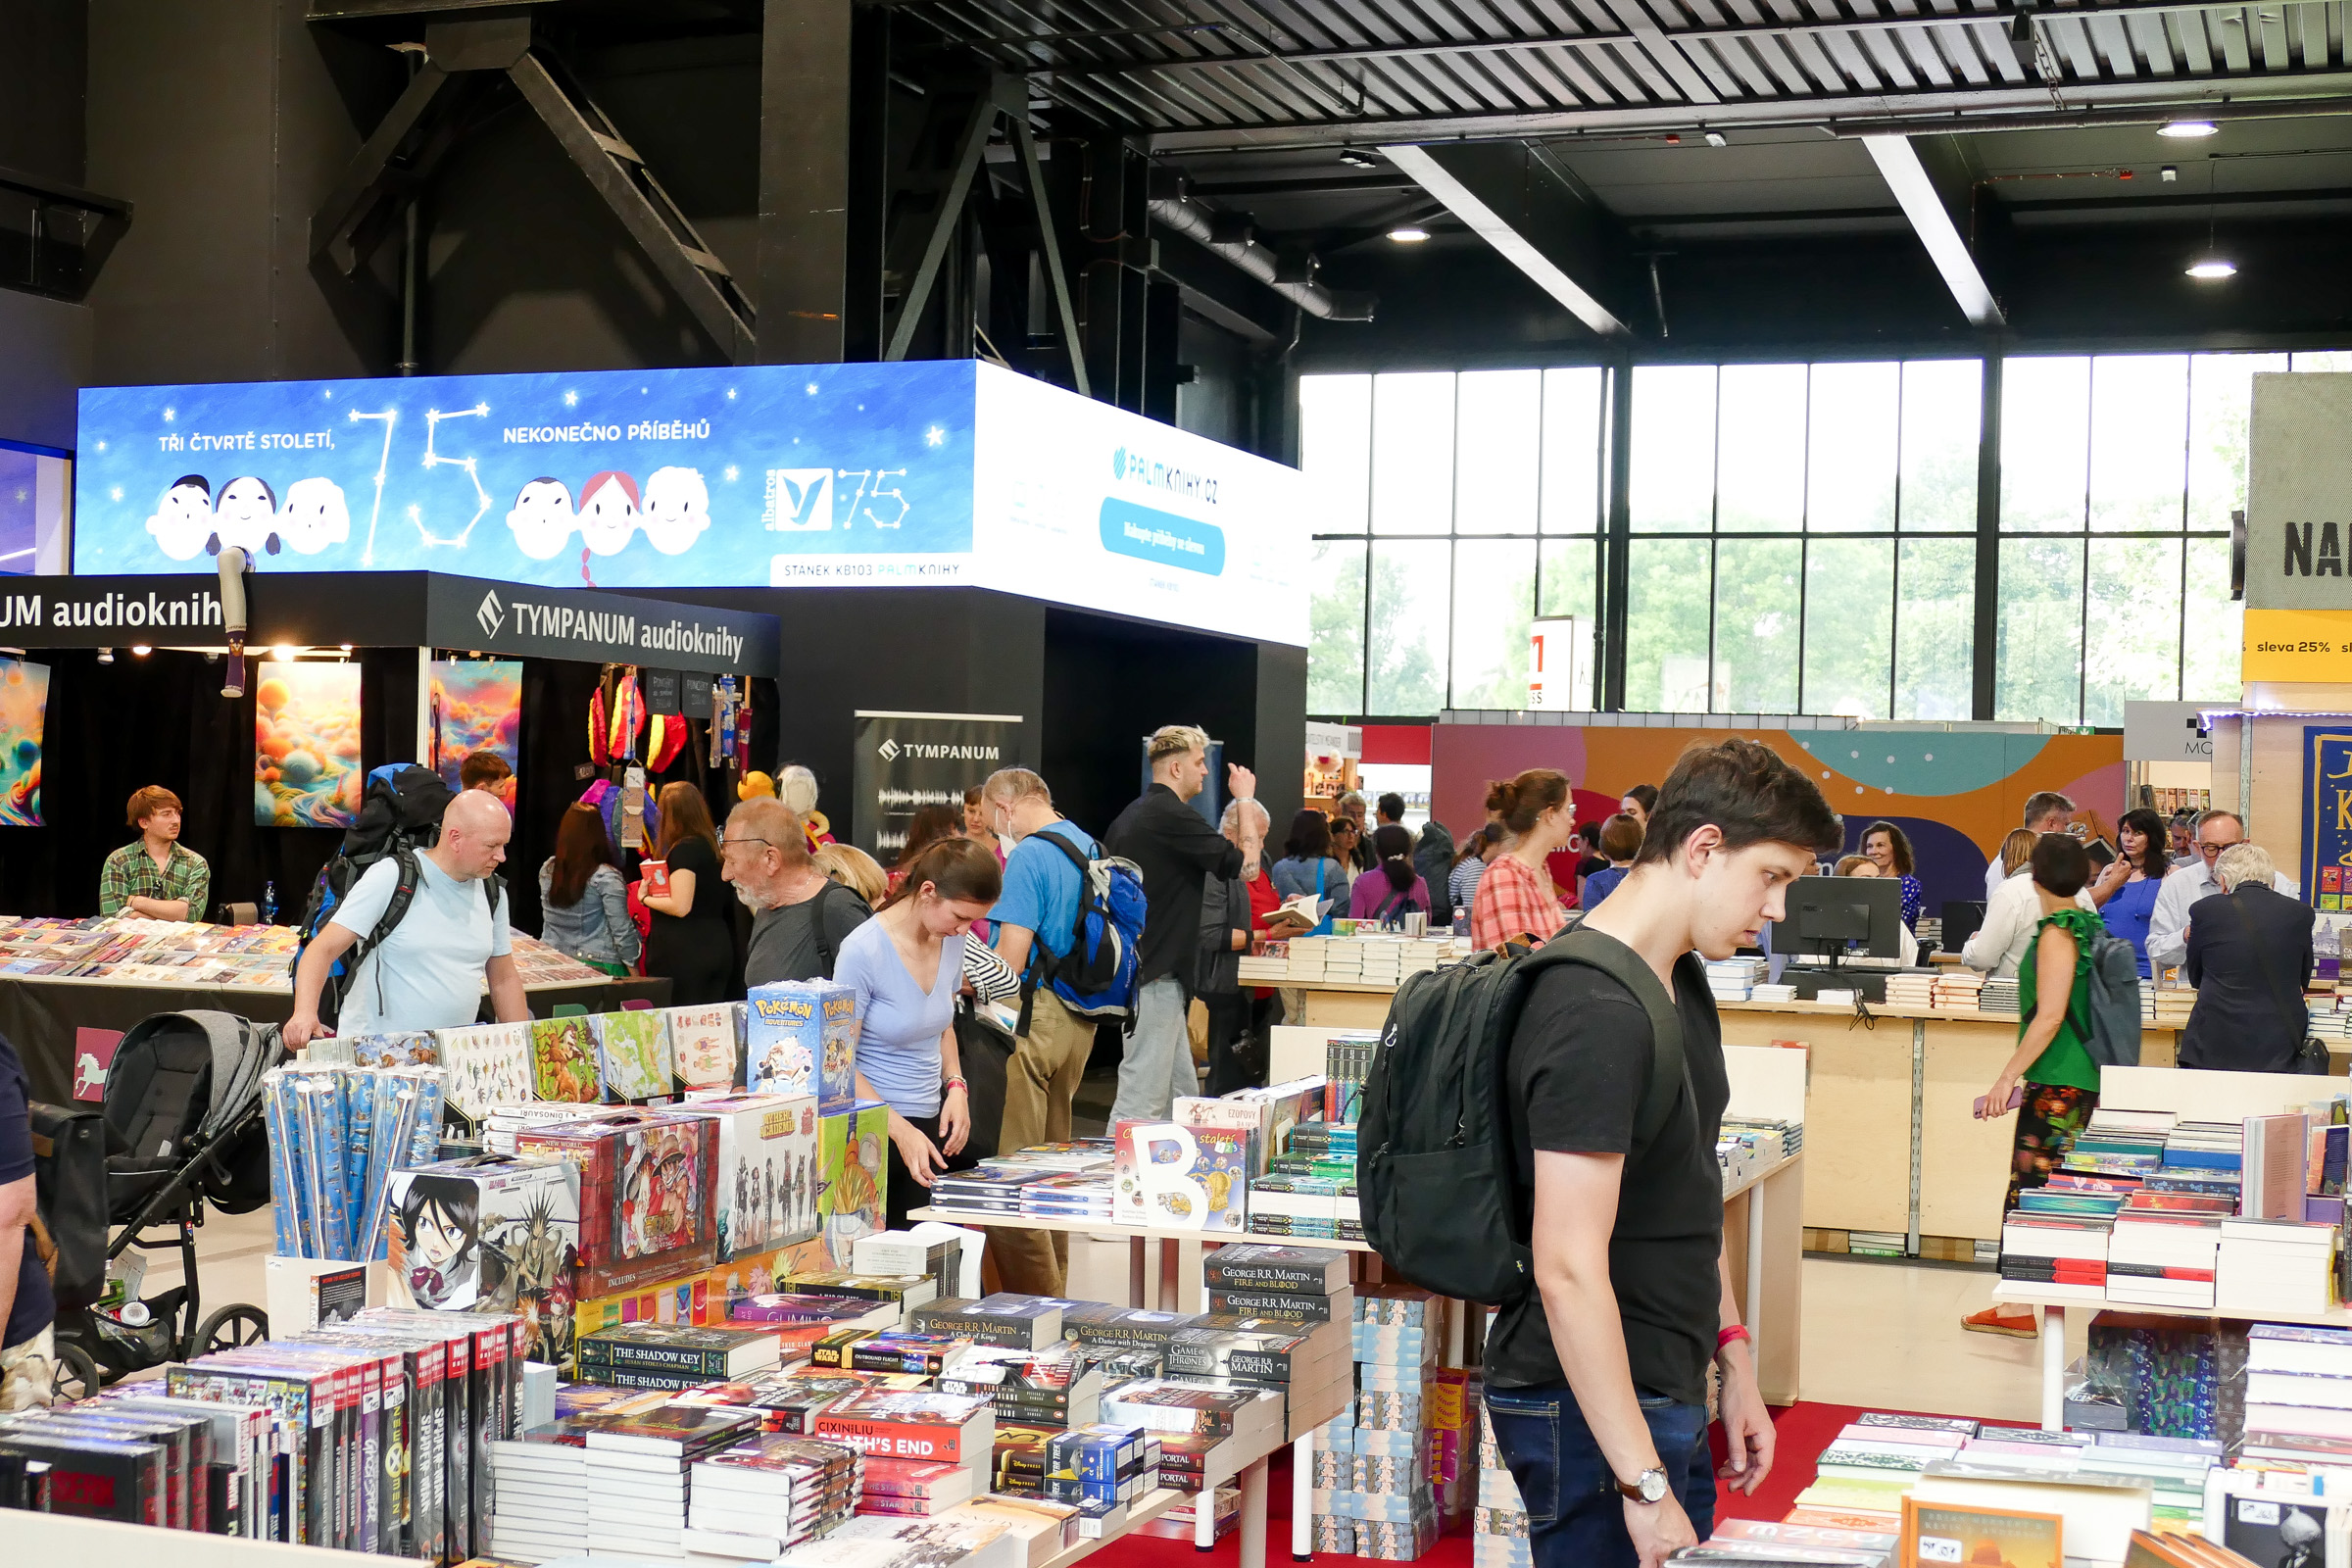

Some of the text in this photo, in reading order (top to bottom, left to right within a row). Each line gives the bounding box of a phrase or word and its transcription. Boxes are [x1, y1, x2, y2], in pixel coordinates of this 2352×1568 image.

[504, 417, 710, 443] NEKONEČNO PŘÍBĚHŮ
[159, 428, 335, 452] TŘI ČTVRTĚ STOLETÍ,
[761, 468, 776, 531] albatros
[838, 467, 910, 530] 75
[2283, 521, 2352, 577] NA
[784, 563, 831, 576] STÁNEK
[836, 564, 873, 576] KB103
[53, 591, 222, 627] audioknih
[512, 602, 744, 664] TYMPANUM audioknihy
[2256, 641, 2330, 654] sleva 25%
[904, 743, 1000, 760] TYMPANUM
[764, 1018, 805, 1027] ADVENTURES
[1228, 1109, 1256, 1119] EZOPOVY
[1132, 1124, 1209, 1231] B
[608, 1274, 636, 1288] INCLUDES
[1222, 1266, 1256, 1278] GEORGE
[1275, 1269, 1310, 1282] MARTIN
[1269, 1280, 1298, 1289] BLOOD
[1227, 1295, 1261, 1306] GEORGE
[1280, 1298, 1315, 1311] MARTIN
[1239, 1307, 1258, 1316] FIRE
[1274, 1309, 1303, 1318] BLOOD
[930, 1319, 963, 1331] GEORGE
[982, 1323, 1017, 1335] MARTIN
[1080, 1326, 1114, 1338] GEORGE
[1132, 1329, 1167, 1342] MARTIN
[1098, 1337, 1116, 1346] Dance
[1132, 1340, 1156, 1348] Dragons
[614, 1347, 701, 1365] THE SHADOW KEY
[1171, 1345, 1199, 1355] GAME
[814, 1354, 840, 1363] WARS
[1168, 1353, 1206, 1366] THRONES
[1231, 1355, 1260, 1364] GEORGE
[1231, 1361, 1273, 1374] MARTIN
[615, 1374, 636, 1386] THE
[637, 1376, 679, 1390] SHADOW
[942, 1379, 967, 1388] STAR
[818, 1422, 851, 1435] CIXIN
[855, 1423, 873, 1436] LIU
[335, 1446, 341, 1455] BY
[350, 1441, 356, 1450] BY
[897, 1440, 934, 1456] END
[1053, 1444, 1061, 1459] TREK
[1161, 1453, 1190, 1464] PORTAL
[1159, 1473, 1189, 1484] PORTAL
[227, 1471, 239, 1510] MARVEL
